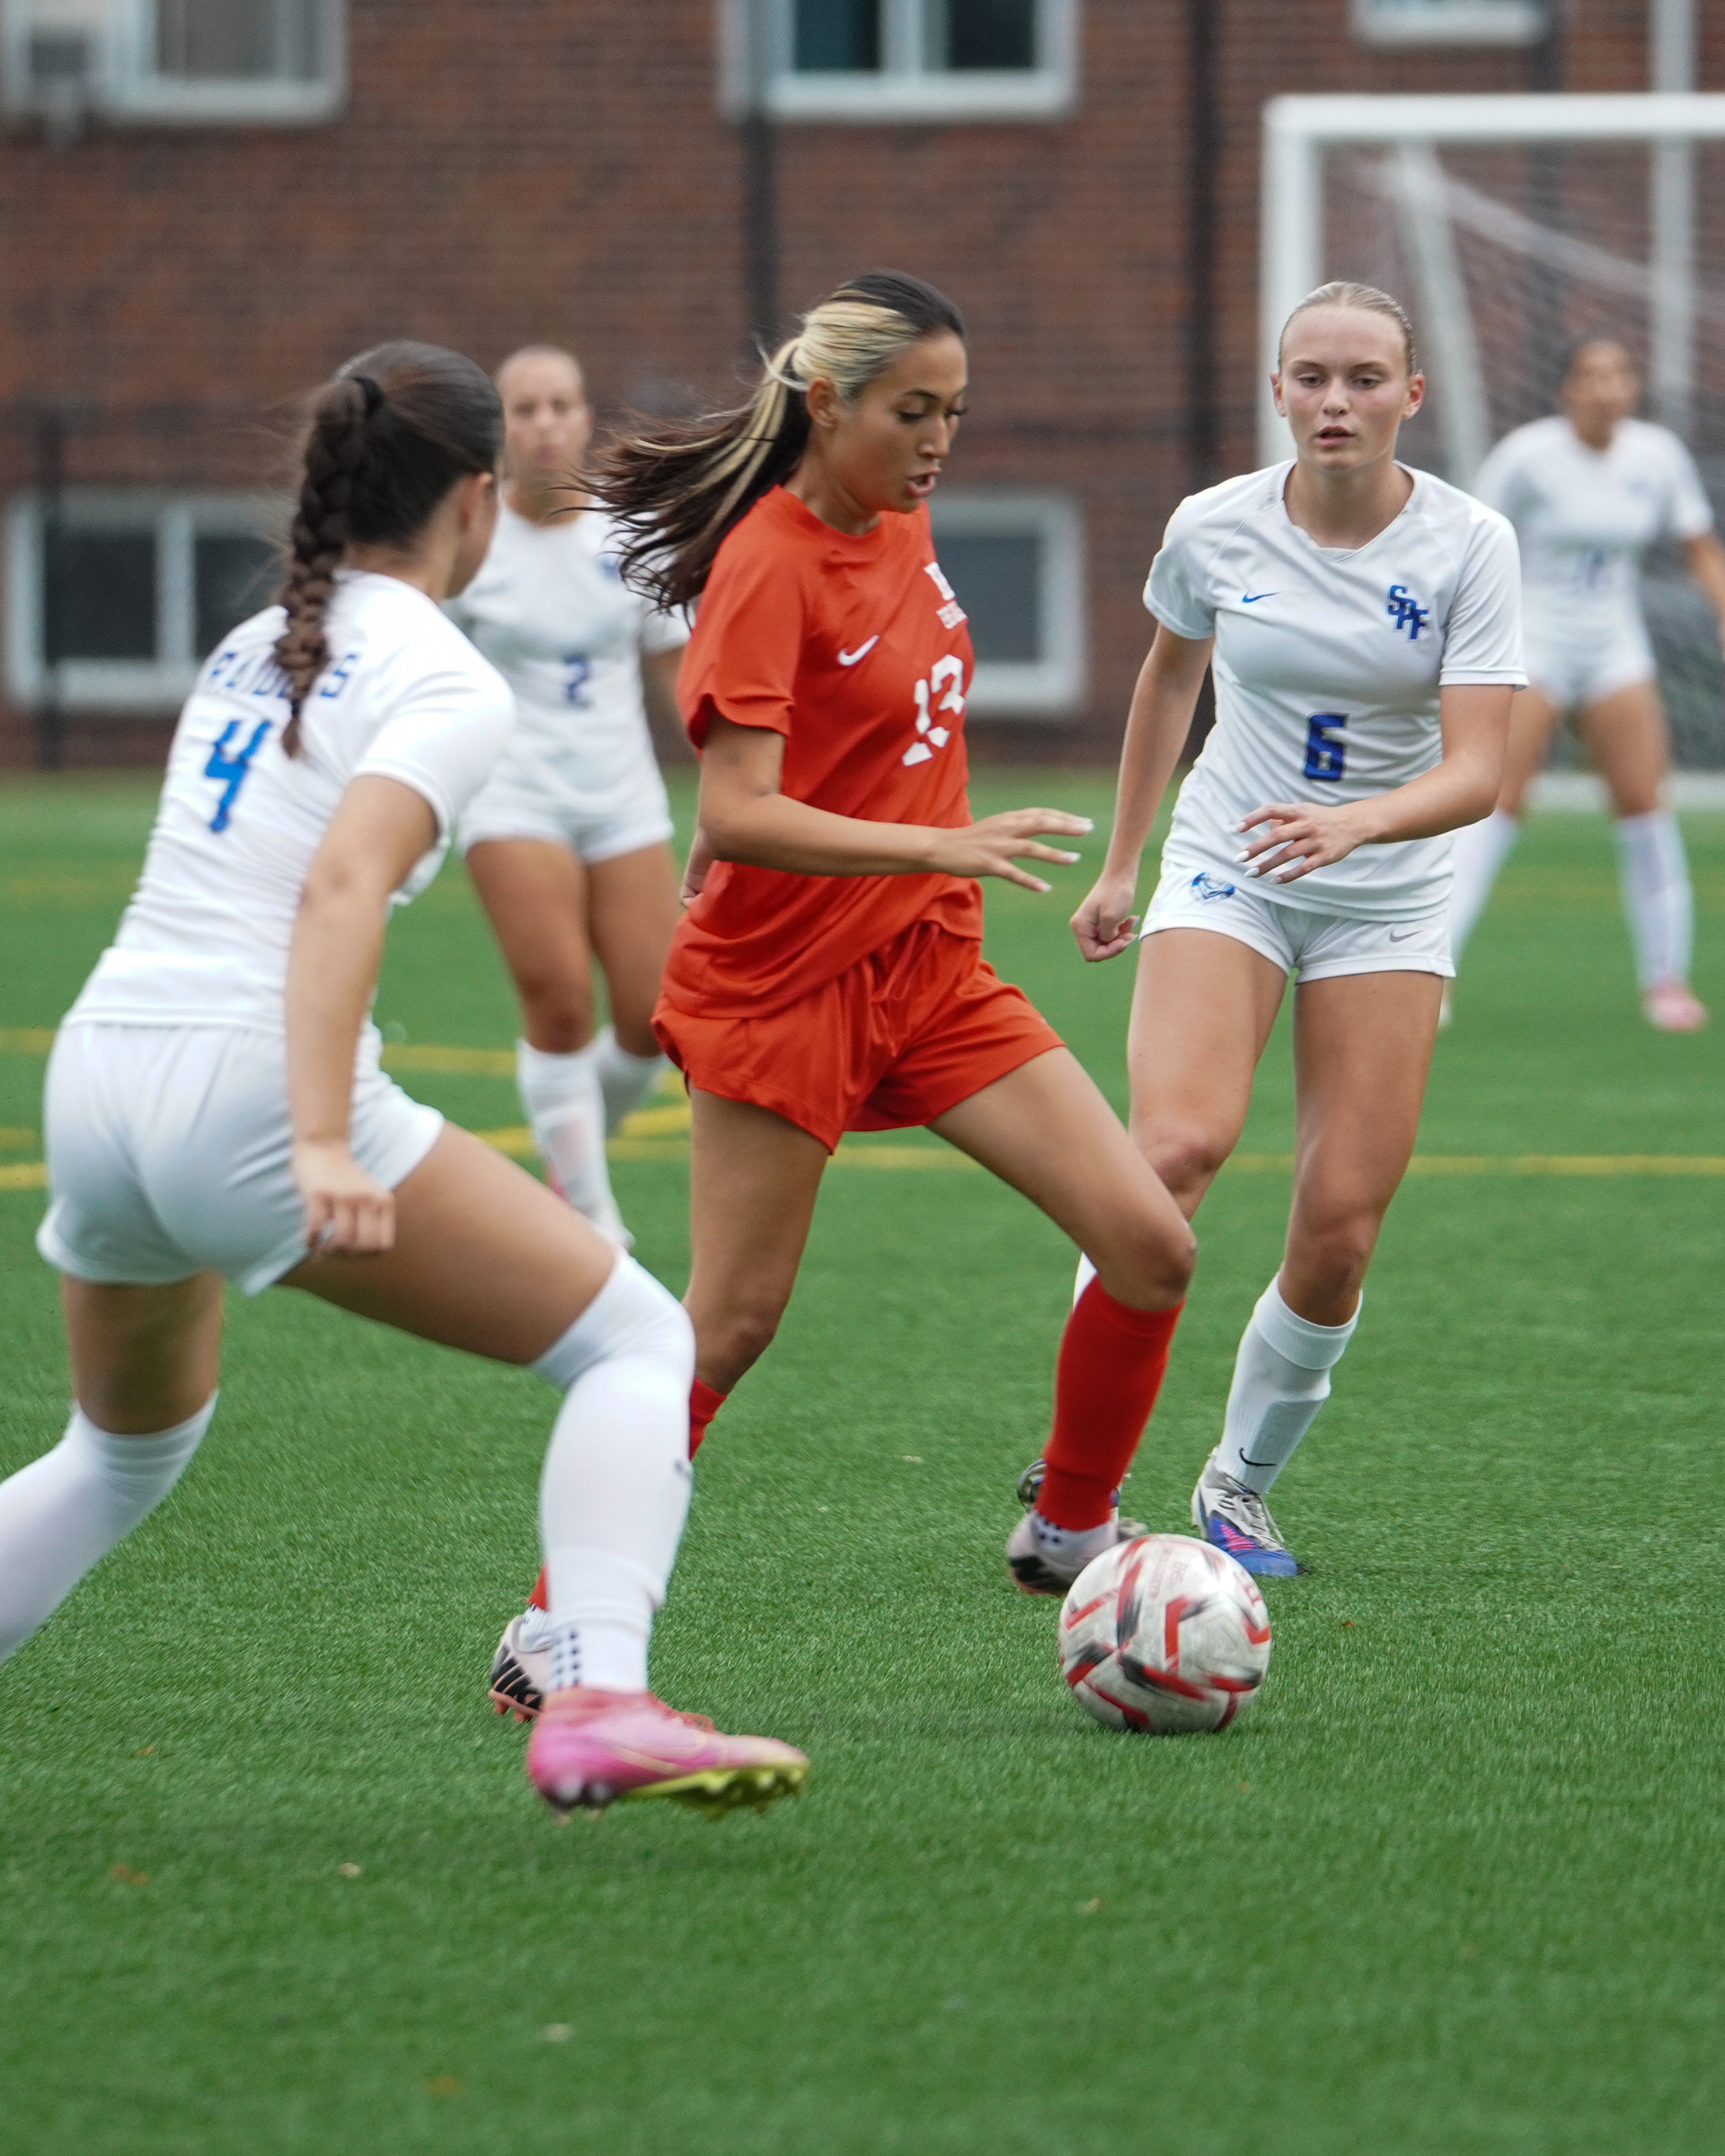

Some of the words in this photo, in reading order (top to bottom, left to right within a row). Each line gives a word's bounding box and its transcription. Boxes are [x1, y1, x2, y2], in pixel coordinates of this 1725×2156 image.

[561, 650, 592, 707] 2
[203, 719, 272, 834] 4
[1303, 712, 1349, 780] 6
